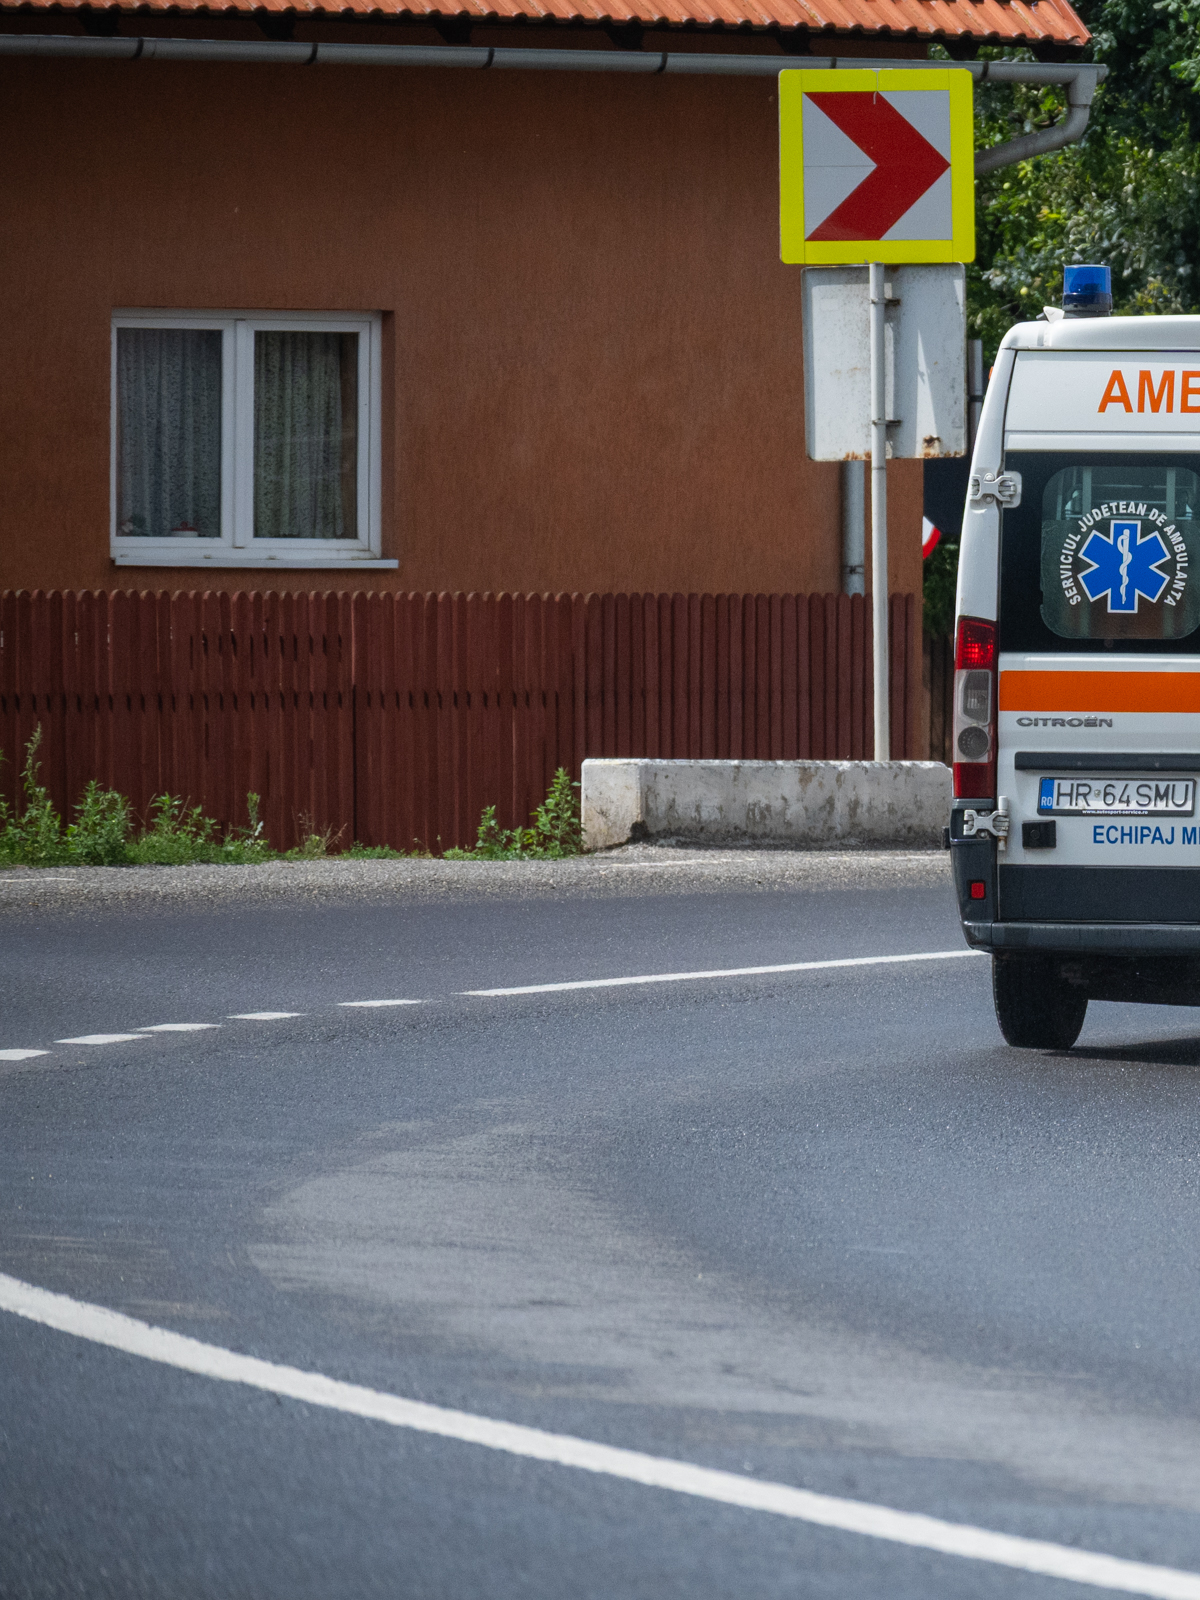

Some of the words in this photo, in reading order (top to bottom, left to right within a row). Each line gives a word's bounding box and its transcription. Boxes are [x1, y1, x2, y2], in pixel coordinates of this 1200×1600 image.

[1060, 533, 1081, 606] SERVICIUL
[1078, 501, 1147, 532] JUDETEAN
[1148, 508, 1167, 527] DE
[1163, 524, 1188, 607] AMBULANTA
[1016, 715, 1113, 728] CITROËN
[1041, 796, 1053, 806] RO
[1056, 783, 1091, 807] HR
[1103, 784, 1130, 807] 64
[1136, 784, 1189, 808] SMU
[1092, 825, 1174, 845] ECHIPAJ
